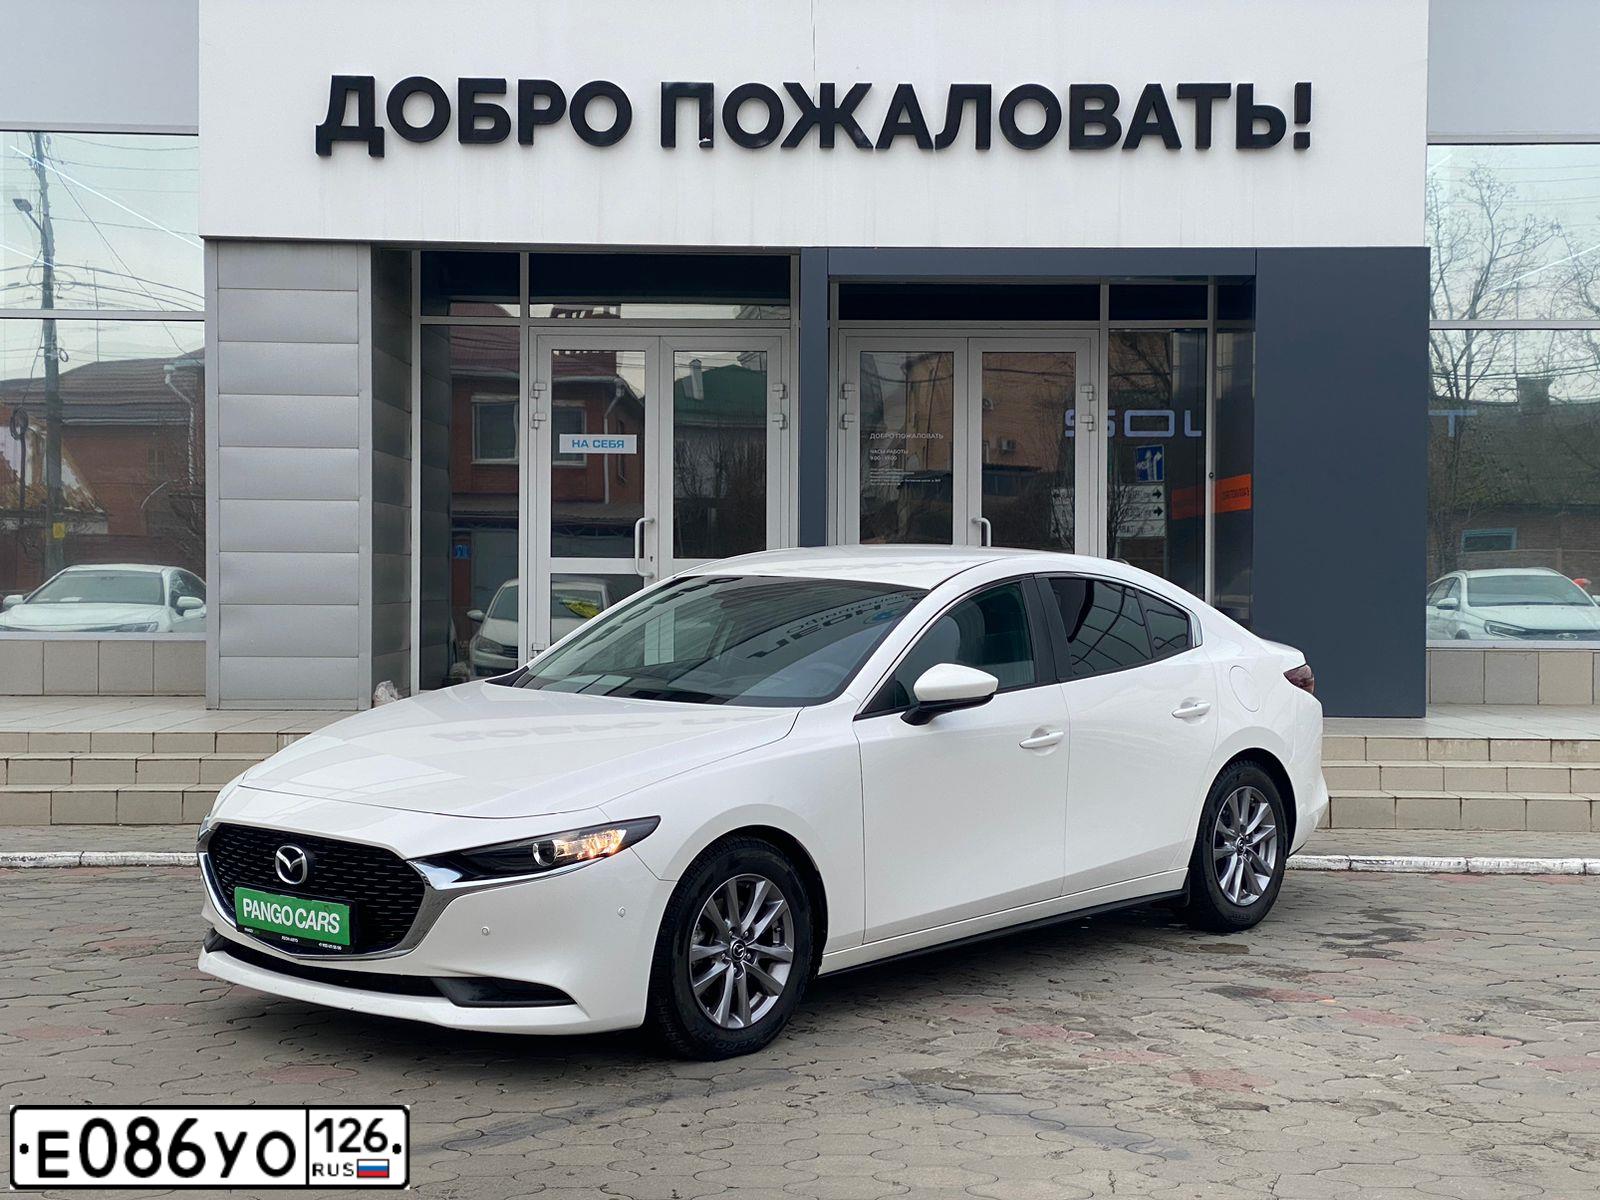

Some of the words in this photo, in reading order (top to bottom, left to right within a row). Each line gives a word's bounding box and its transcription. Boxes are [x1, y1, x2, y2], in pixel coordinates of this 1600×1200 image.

[316, 75, 632, 158] ДОБРО
[660, 82, 1312, 151] ПОЖАЛОВАТЬ!
[572, 439, 589, 449] НА
[592, 439, 624, 449] СЕБЯ
[242, 897, 294, 926] PANGO
[295, 908, 340, 934] CARS
